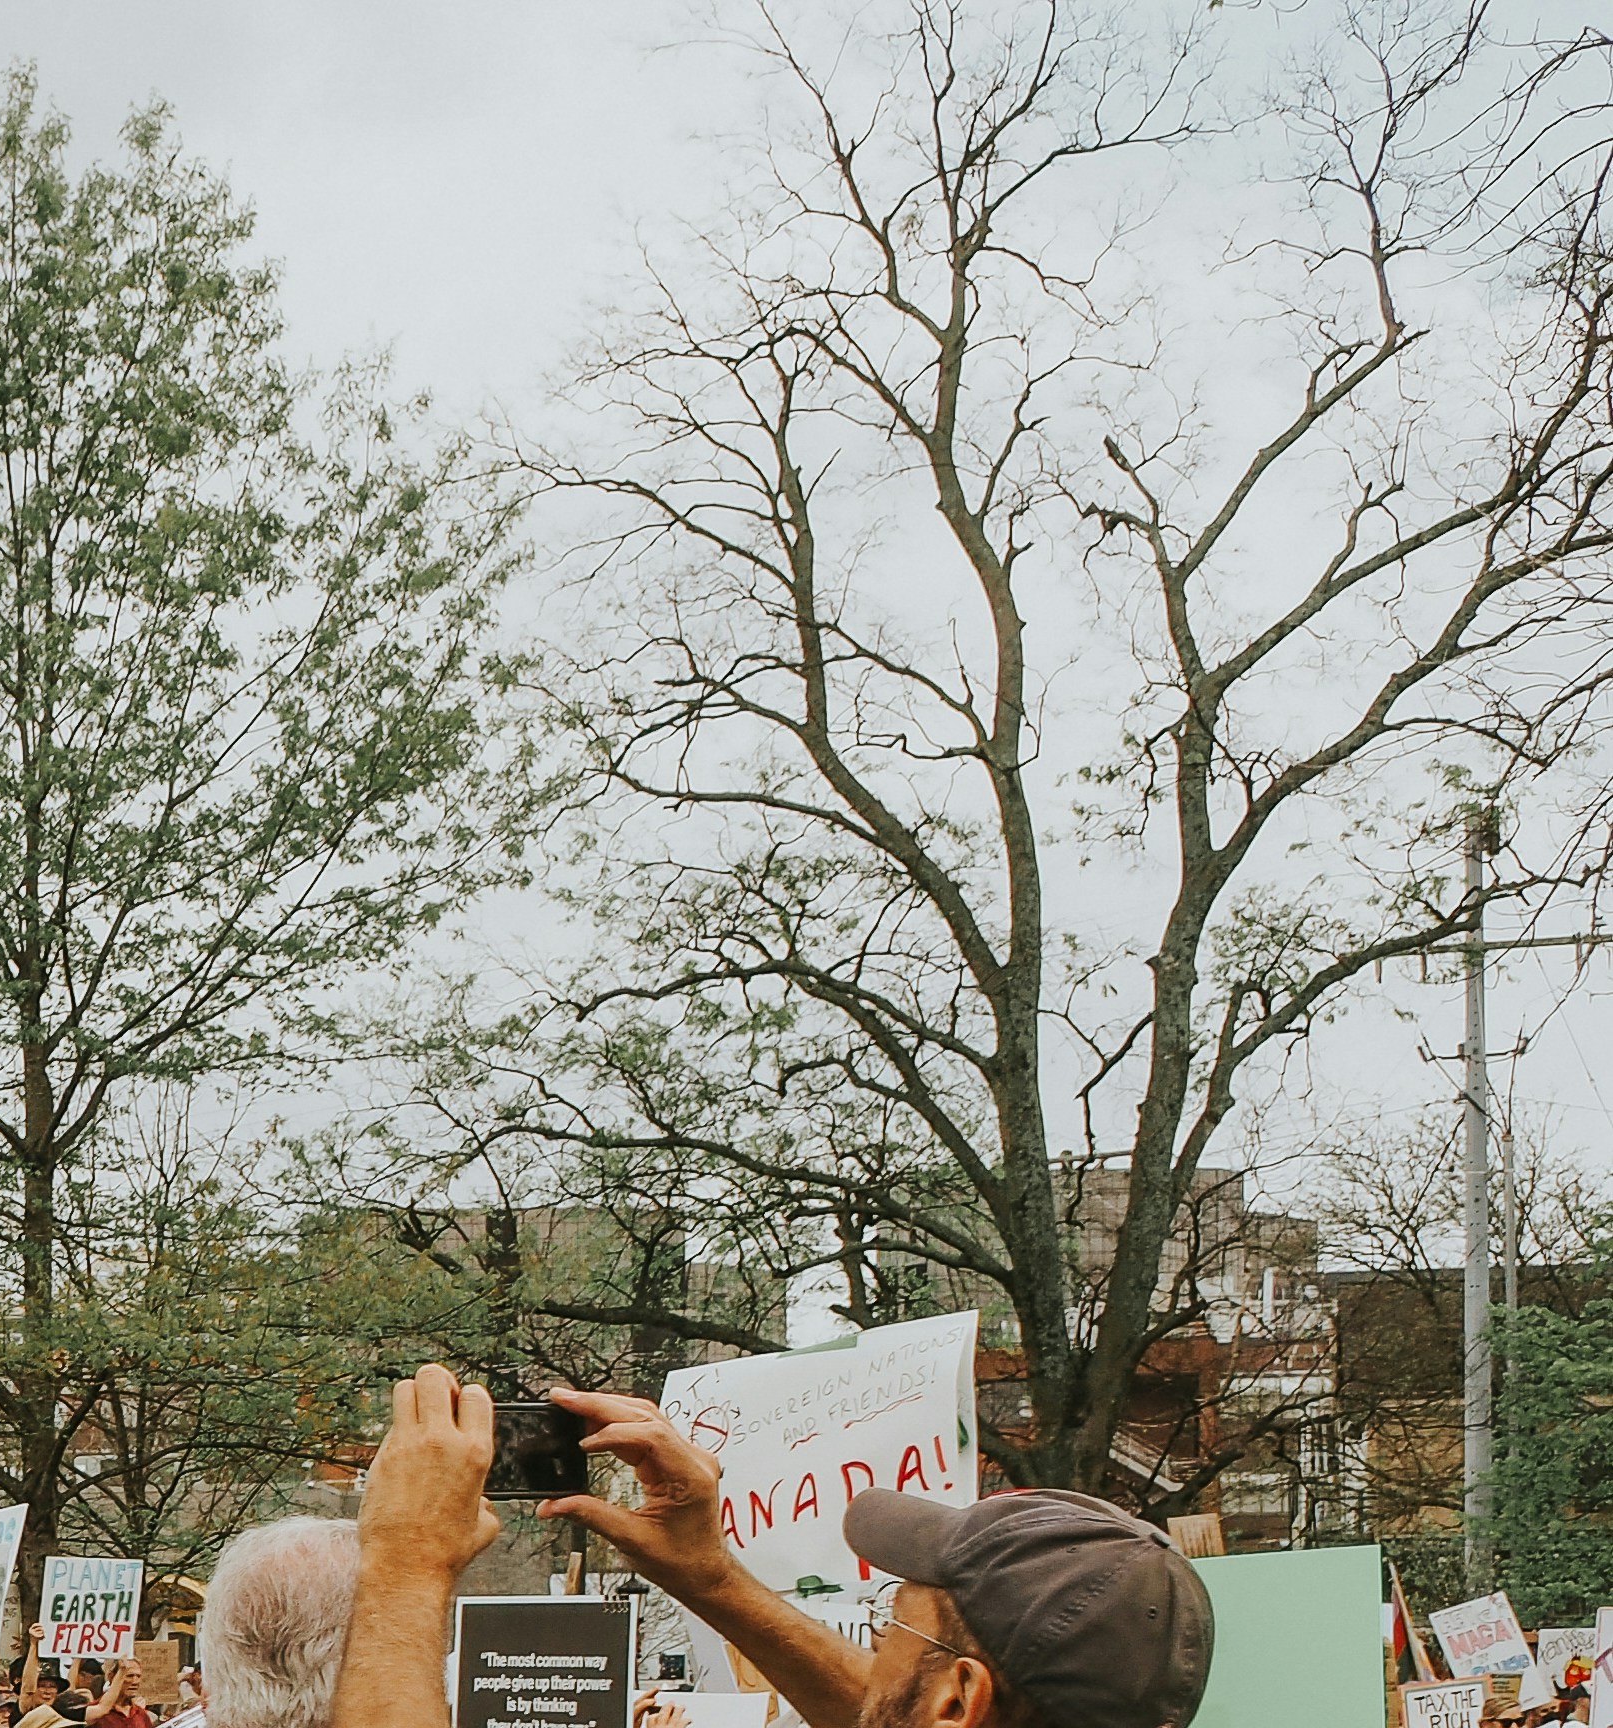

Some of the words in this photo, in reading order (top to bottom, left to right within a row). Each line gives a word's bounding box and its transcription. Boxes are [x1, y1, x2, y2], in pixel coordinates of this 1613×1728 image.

[731, 1370, 853, 1446] SOVEREIGN
[782, 1417, 816, 1446] AND
[828, 1361, 937, 1421] FRIENDS!
[721, 1435, 953, 1549] ANADA!
[49, 1559, 143, 1591] PLANET
[50, 1591, 133, 1623] EARTH
[52, 1621, 131, 1654] FIRST
[507, 1653, 536, 1668] most
[536, 1655, 583, 1668] common
[584, 1656, 607, 1671] way
[473, 1674, 511, 1692] people
[511, 1674, 535, 1692] give
[535, 1678, 550, 1693] up
[550, 1675, 576, 1691] their
[576, 1677, 613, 1693] power
[506, 1696, 517, 1711] is
[517, 1696, 532, 1714] by
[532, 1697, 578, 1716] thinking
[1414, 1692, 1451, 1715] TAX
[1451, 1688, 1480, 1710] THE
